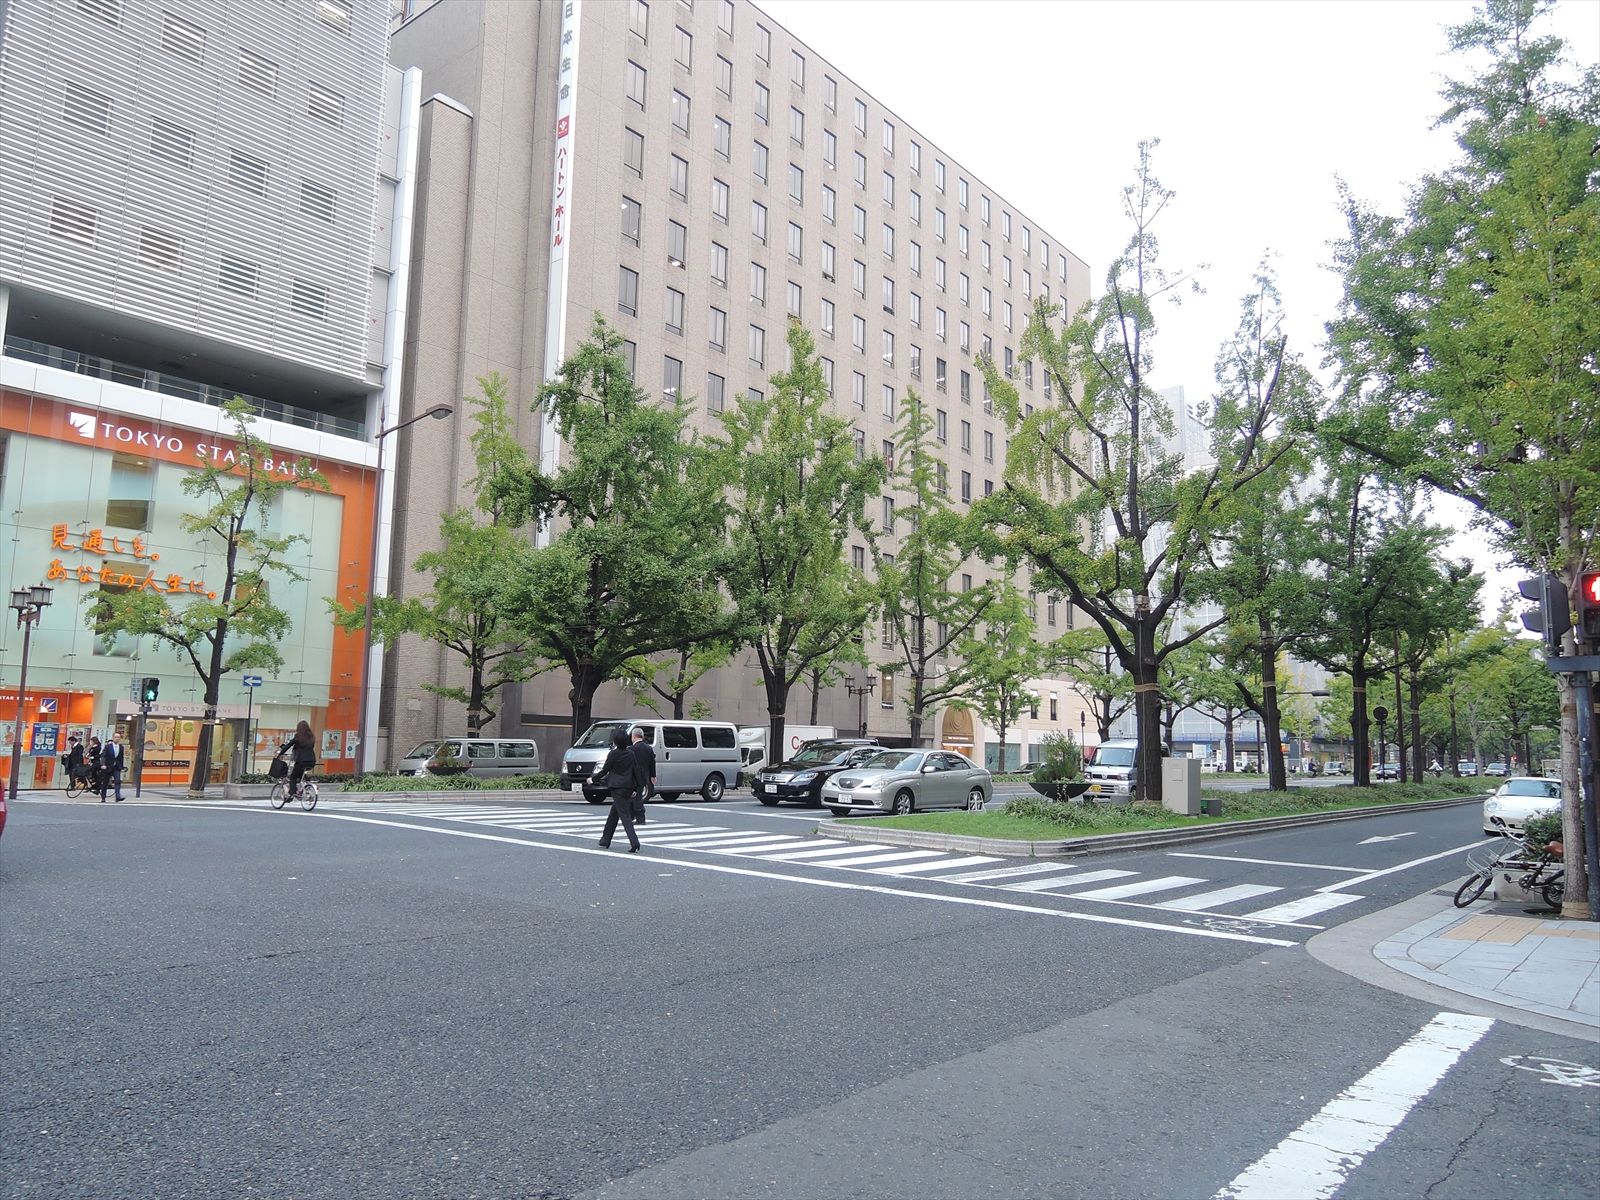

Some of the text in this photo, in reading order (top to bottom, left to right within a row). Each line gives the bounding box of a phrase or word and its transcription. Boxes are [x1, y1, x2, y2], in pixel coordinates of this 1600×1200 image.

[560, 1, 574, 100] 日本生命
[101, 422, 183, 453] TOKYO
[196, 443, 252, 469] STAR
[51, 522, 160, 562] 見通しを。
[47, 558, 217, 600] あなたの人生に。
[162, 704, 187, 712] TOKYO
